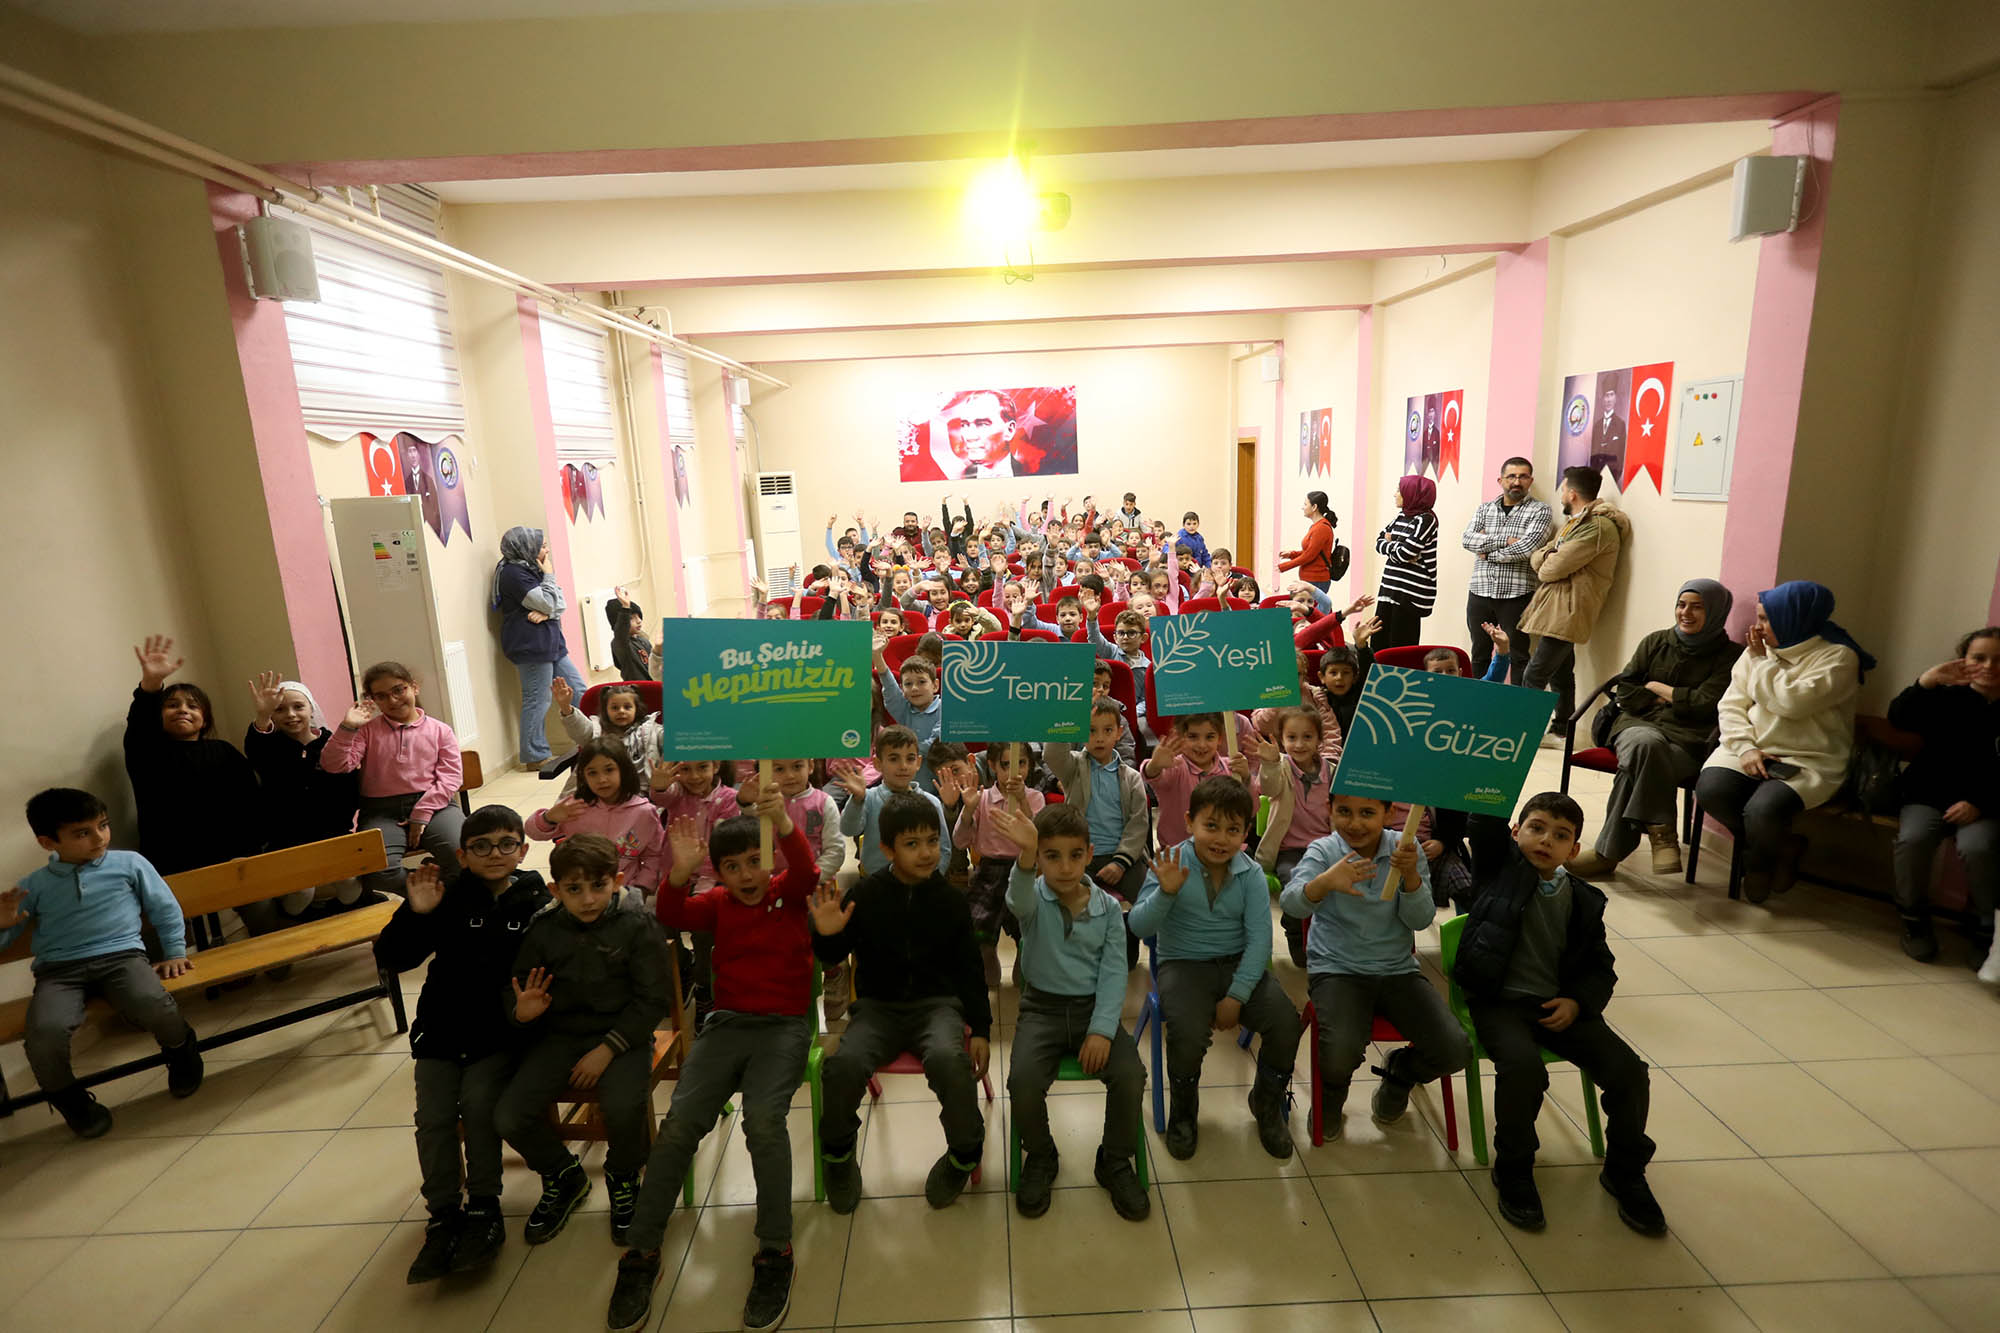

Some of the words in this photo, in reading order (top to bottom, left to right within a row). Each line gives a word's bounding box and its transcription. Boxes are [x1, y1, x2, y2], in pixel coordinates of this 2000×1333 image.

[719, 648, 754, 670] Bu
[757, 640, 823, 668] Şehir
[1207, 639, 1273, 671] Yeşil
[681, 658, 856, 708] Hepimizin
[1001, 675, 1084, 702] Temiz
[1424, 719, 1528, 763] Güzel
